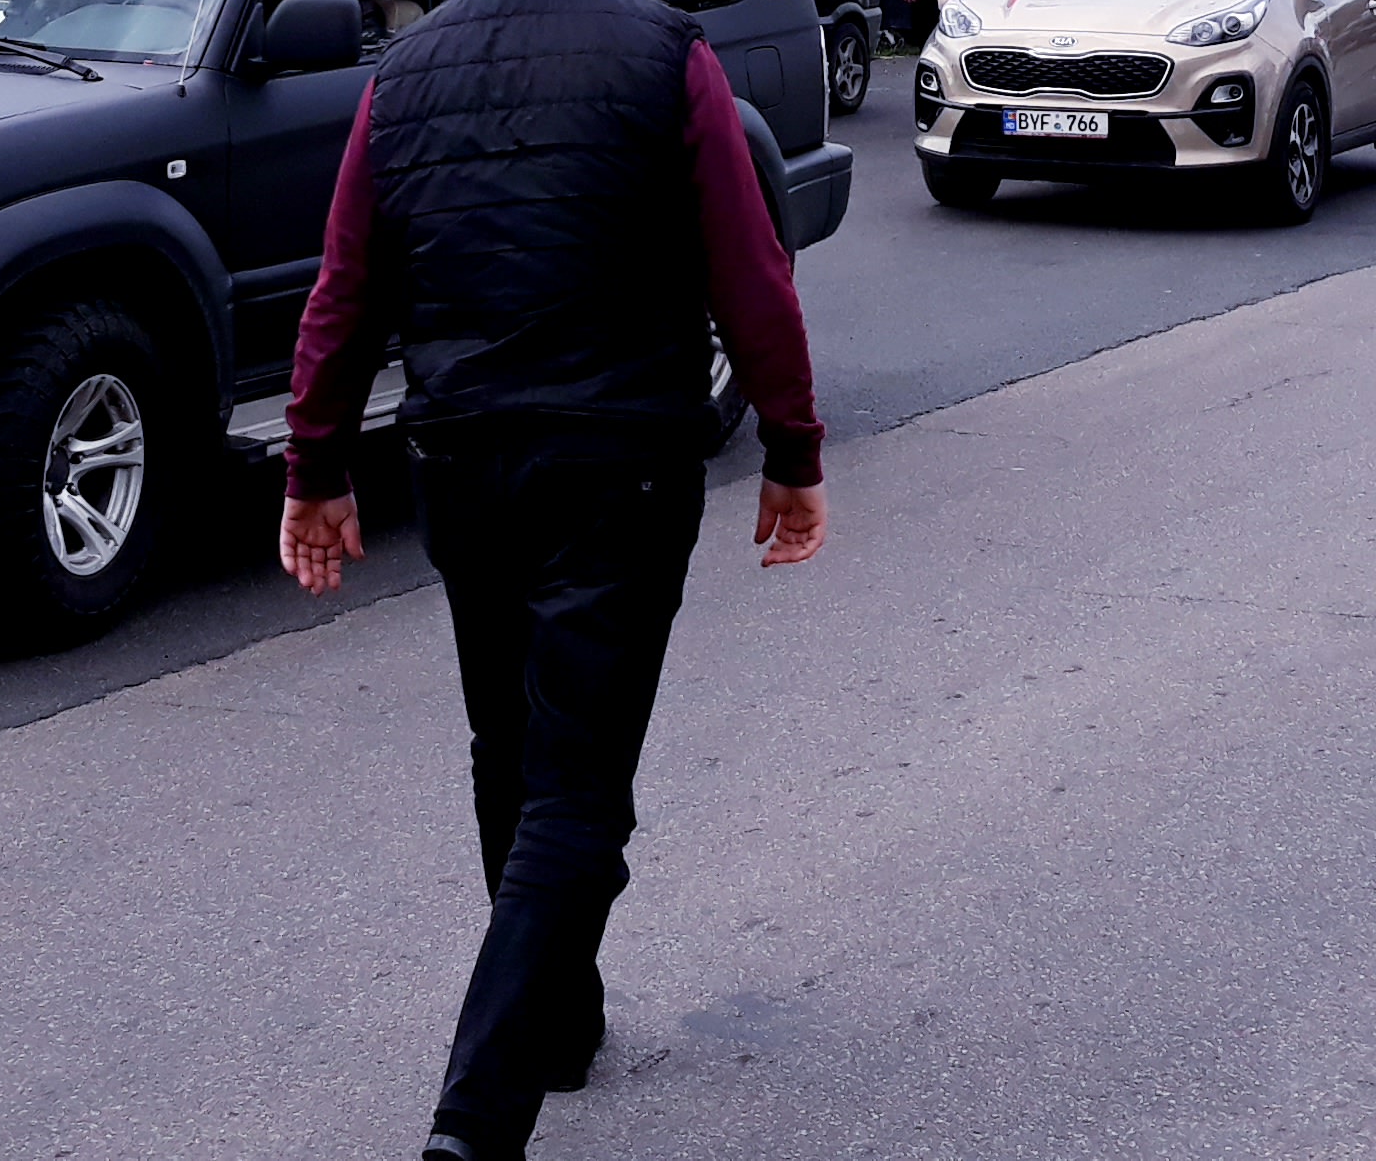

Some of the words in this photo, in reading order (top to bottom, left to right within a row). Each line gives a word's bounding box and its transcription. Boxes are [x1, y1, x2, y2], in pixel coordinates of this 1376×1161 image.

[1052, 37, 1074, 46] KIA
[1018, 112, 1052, 131] BYF
[1066, 114, 1099, 132] 766
